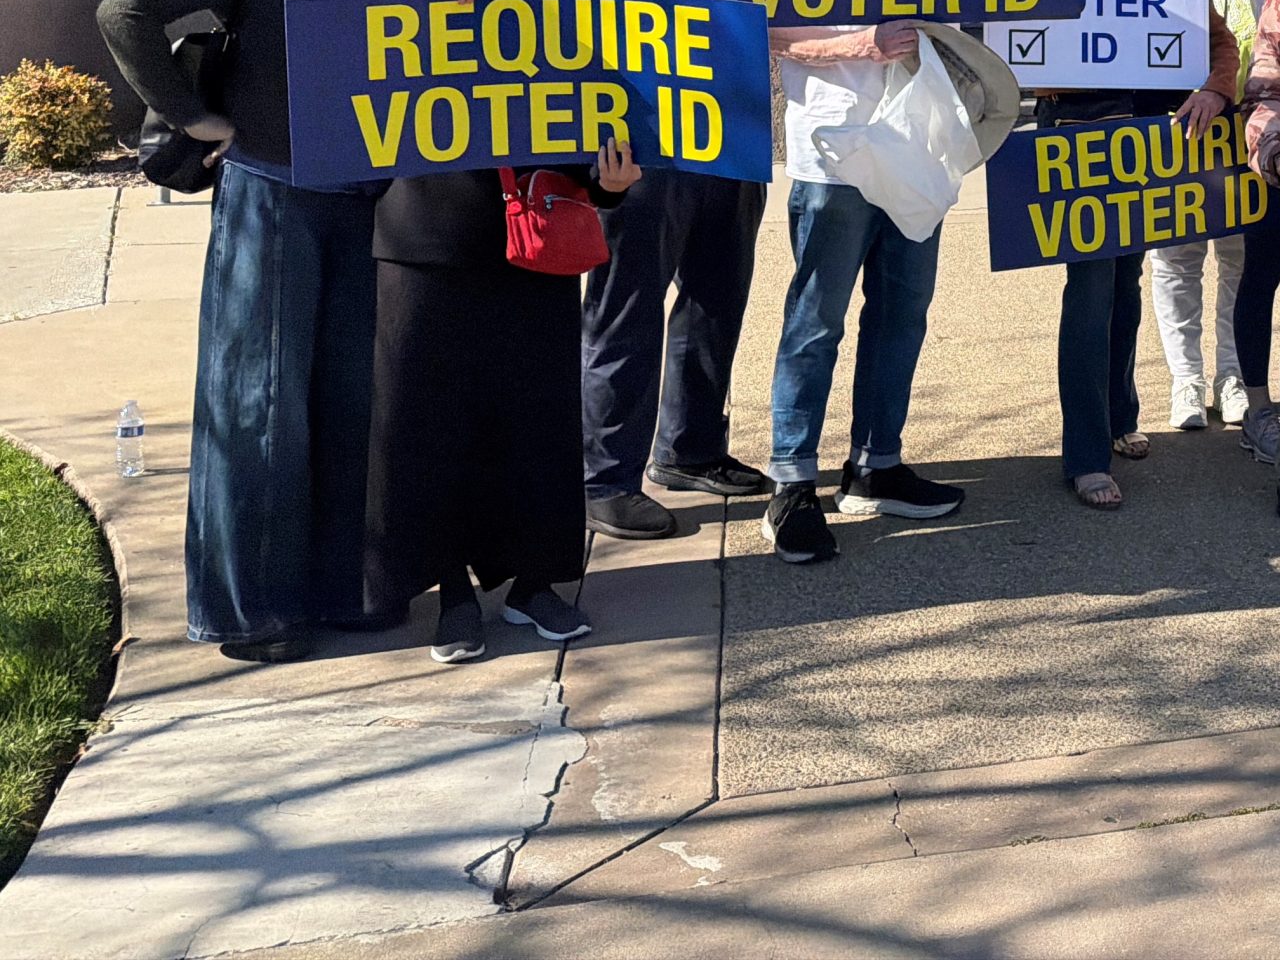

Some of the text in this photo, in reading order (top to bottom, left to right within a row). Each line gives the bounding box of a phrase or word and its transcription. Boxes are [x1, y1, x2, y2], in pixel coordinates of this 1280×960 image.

[1081, 32, 1118, 63] ID
[351, 82, 723, 168] VOTER ID
[1027, 171, 1268, 258] VOTER ID
